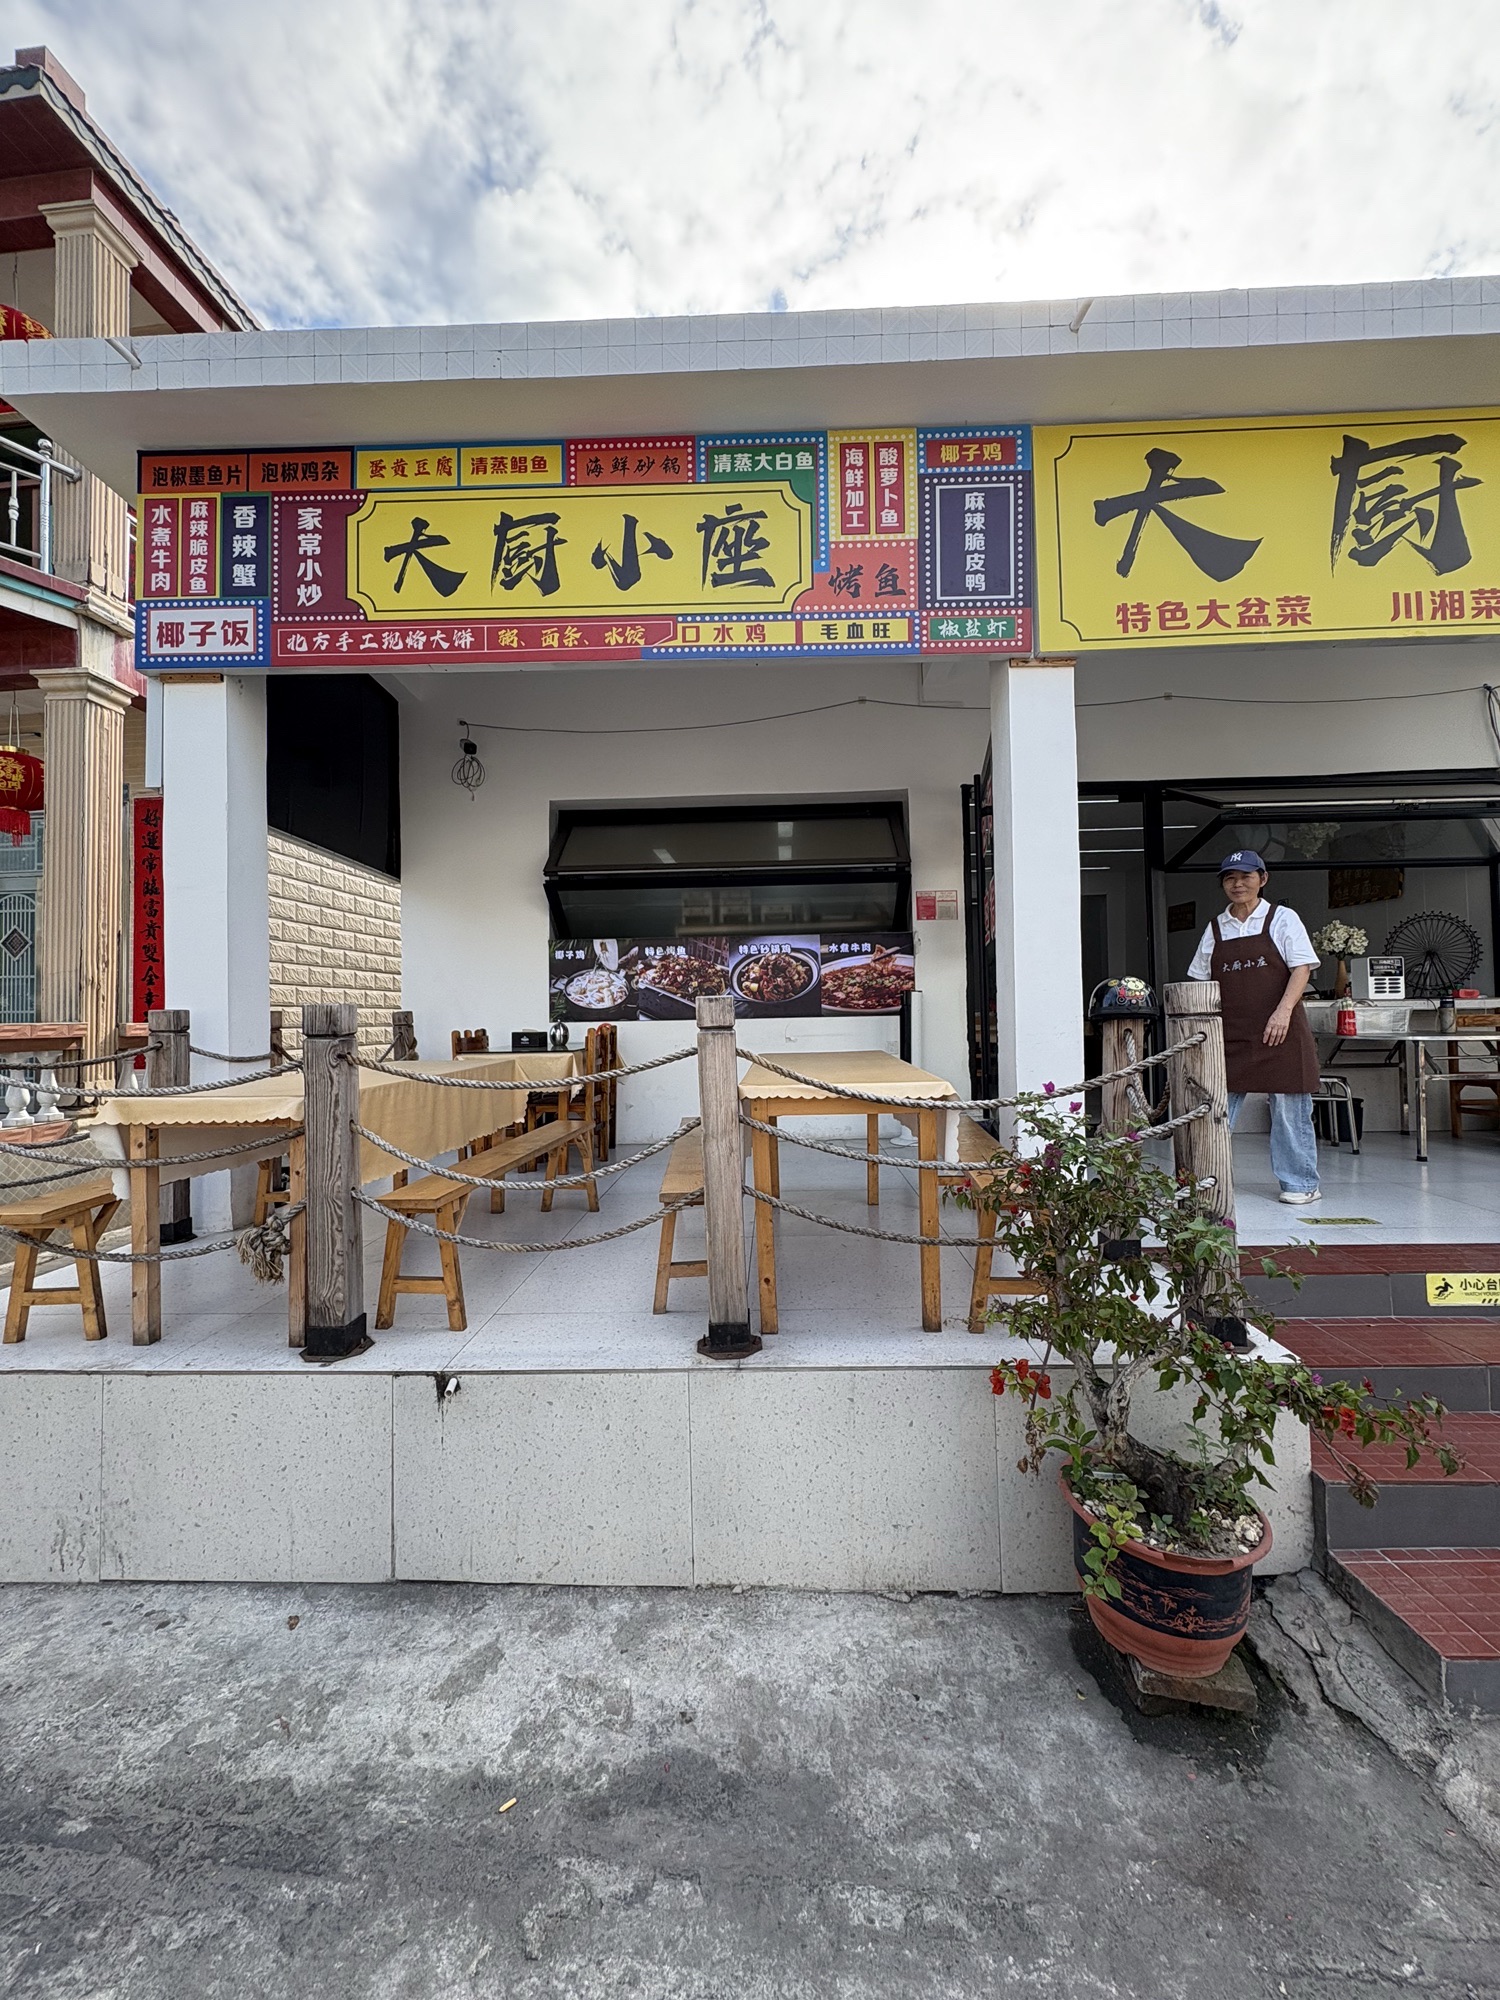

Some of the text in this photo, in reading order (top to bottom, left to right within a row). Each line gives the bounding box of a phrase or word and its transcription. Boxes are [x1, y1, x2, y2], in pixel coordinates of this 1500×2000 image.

[471, 456, 549, 475] 清蒸鲳鱼
[713, 452, 814, 474] 清蒸大白鱼
[940, 443, 1003, 462] 椰子鸡
[152, 465, 242, 487] 泡椒墨鱼片
[261, 460, 340, 483] 泡椒鸡杂
[369, 456, 453, 479] 蛋黄豆腐
[586, 456, 682, 476] 海鲜砂锅
[845, 448, 865, 528] 海鲜加工
[879, 447, 899, 527] 酸萝卜鱼
[1093, 433, 1485, 583] 大厨
[151, 505, 172, 592] 水煮牛肉
[189, 501, 209, 594] 麻辣脆皮鱼
[232, 505, 257, 587] 香辣蟹
[384, 503, 777, 598] 大厨小座
[964, 492, 986, 592] 麻辣脆皮鸭
[297, 508, 322, 607] 家常小炒
[828, 563, 908, 599] 烤鱼
[1116, 595, 1313, 634] 特色大盆菜
[1390, 588, 1500, 622] 川湘菜
[156, 619, 250, 648] 椰子饭
[286, 628, 475, 652] 北方手工现烙大饼
[681, 623, 767, 645] 口水鸡
[820, 622, 892, 640] 毛血旺
[938, 618, 1008, 639] 椒盐虾
[829, 942, 872, 953] 水煮牛肉
[1460, 1278, 1500, 1291] 小心台
